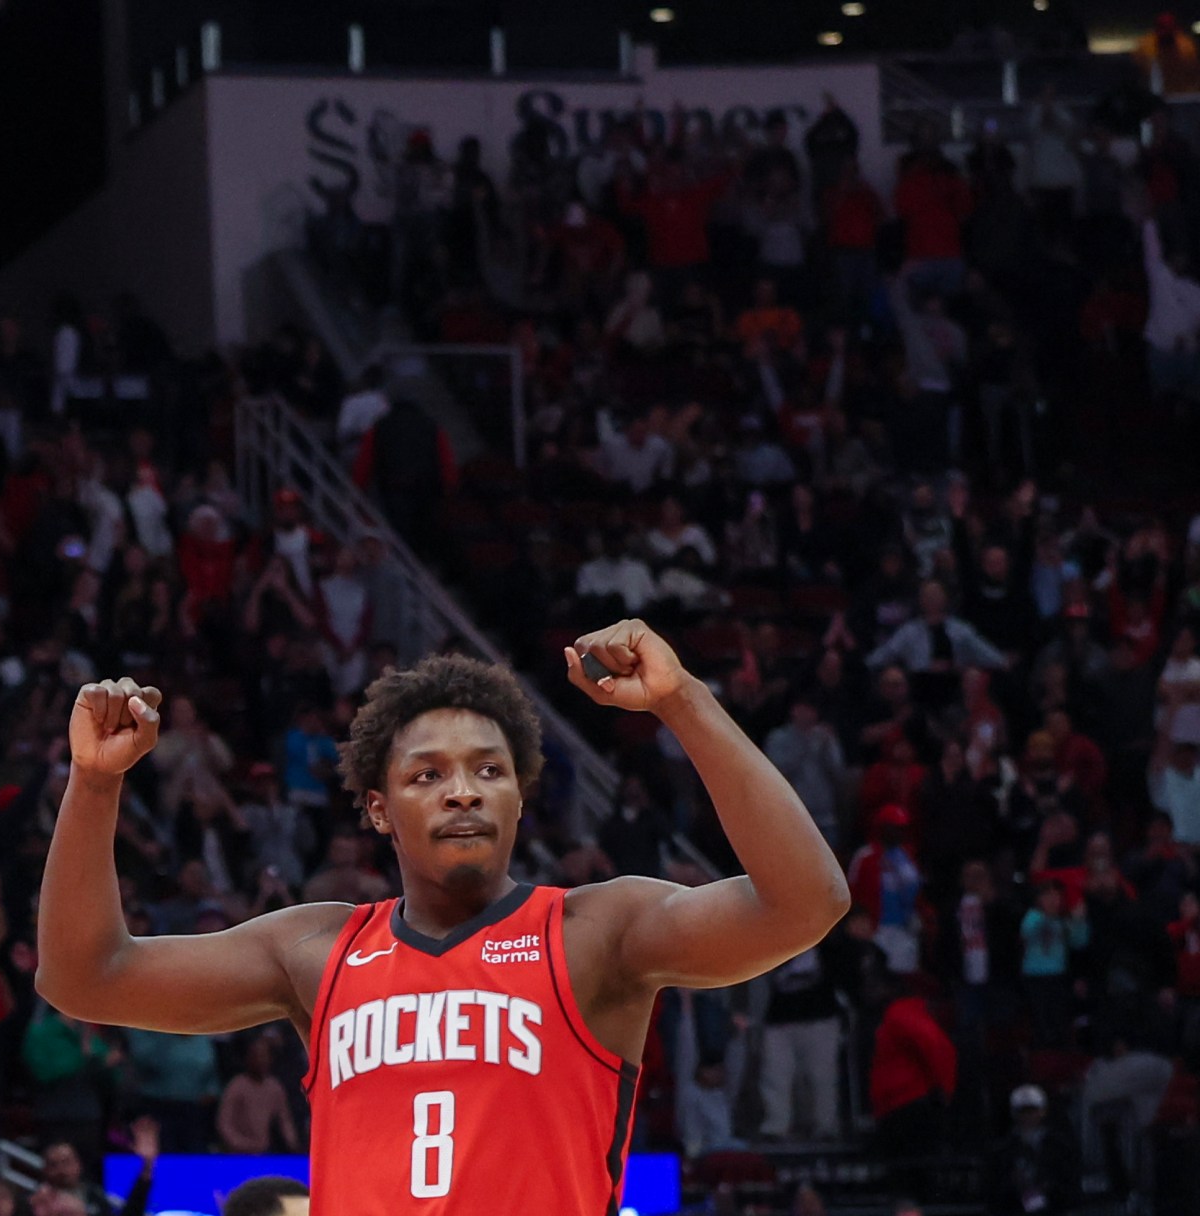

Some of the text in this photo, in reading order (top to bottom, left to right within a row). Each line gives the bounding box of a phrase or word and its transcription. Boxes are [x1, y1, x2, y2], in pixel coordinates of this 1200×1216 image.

[481, 947, 540, 964] karma
[329, 989, 543, 1090] ROCKETS
[410, 1090, 455, 1199] 8
